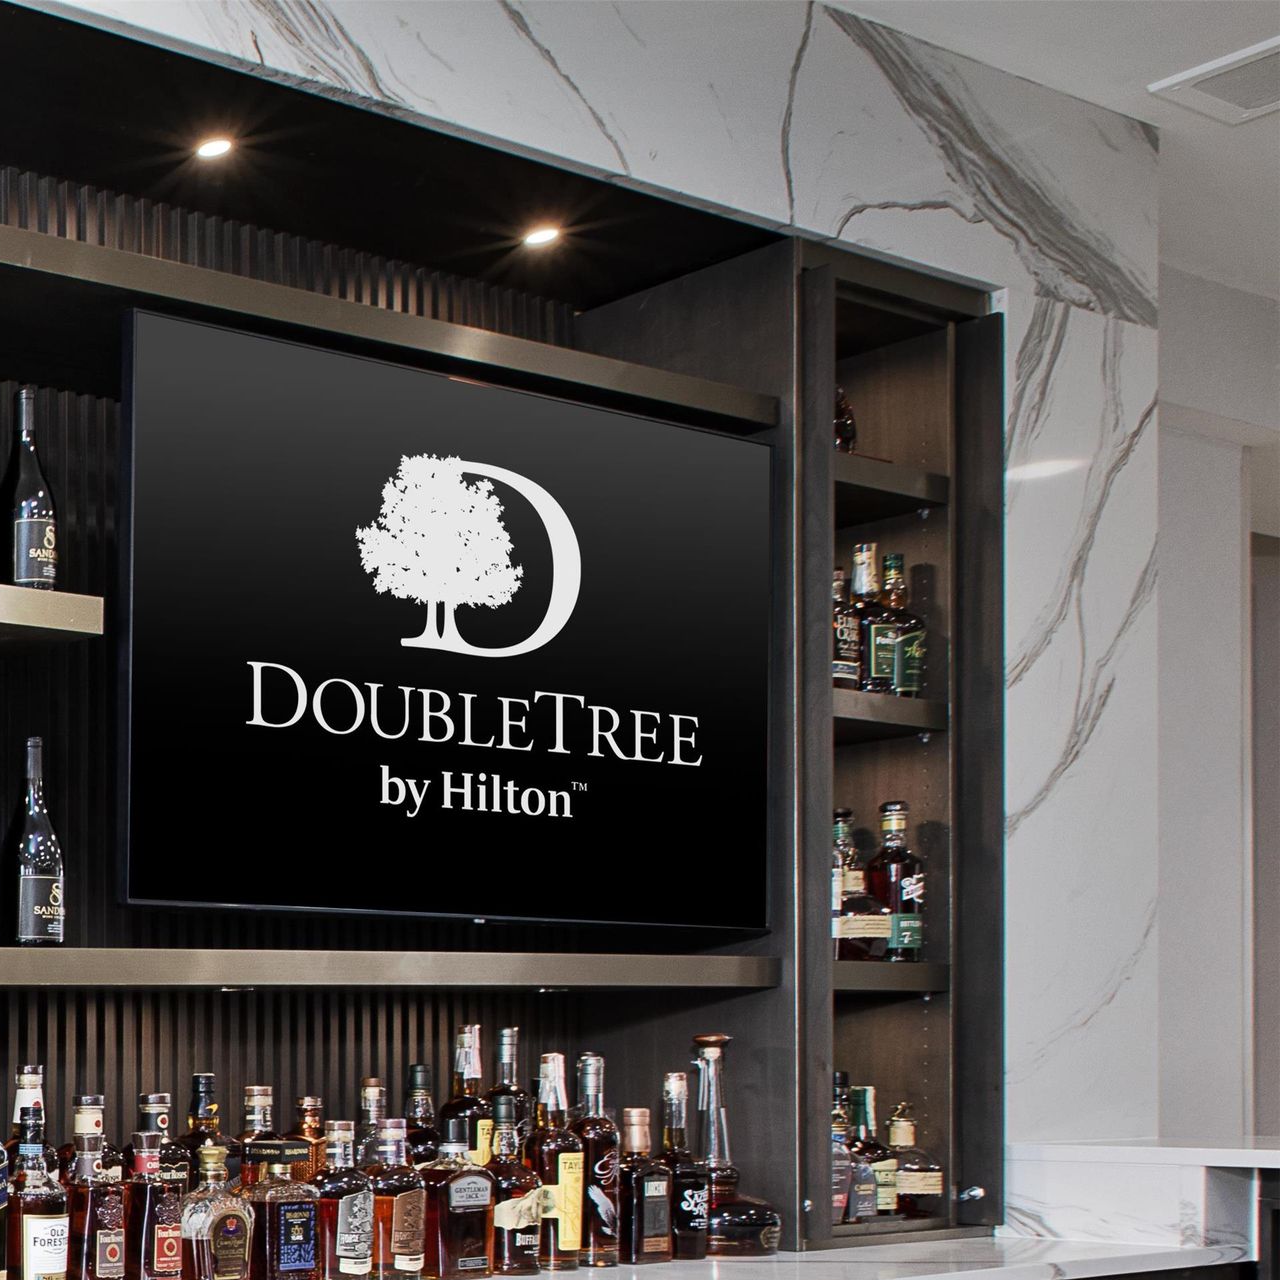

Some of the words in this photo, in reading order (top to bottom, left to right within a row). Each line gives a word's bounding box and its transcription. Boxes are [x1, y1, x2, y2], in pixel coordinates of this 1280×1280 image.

[380, 764, 431, 818] by
[50, 1228, 64, 1237] OLD
[291, 1227, 304, 1236] 500
